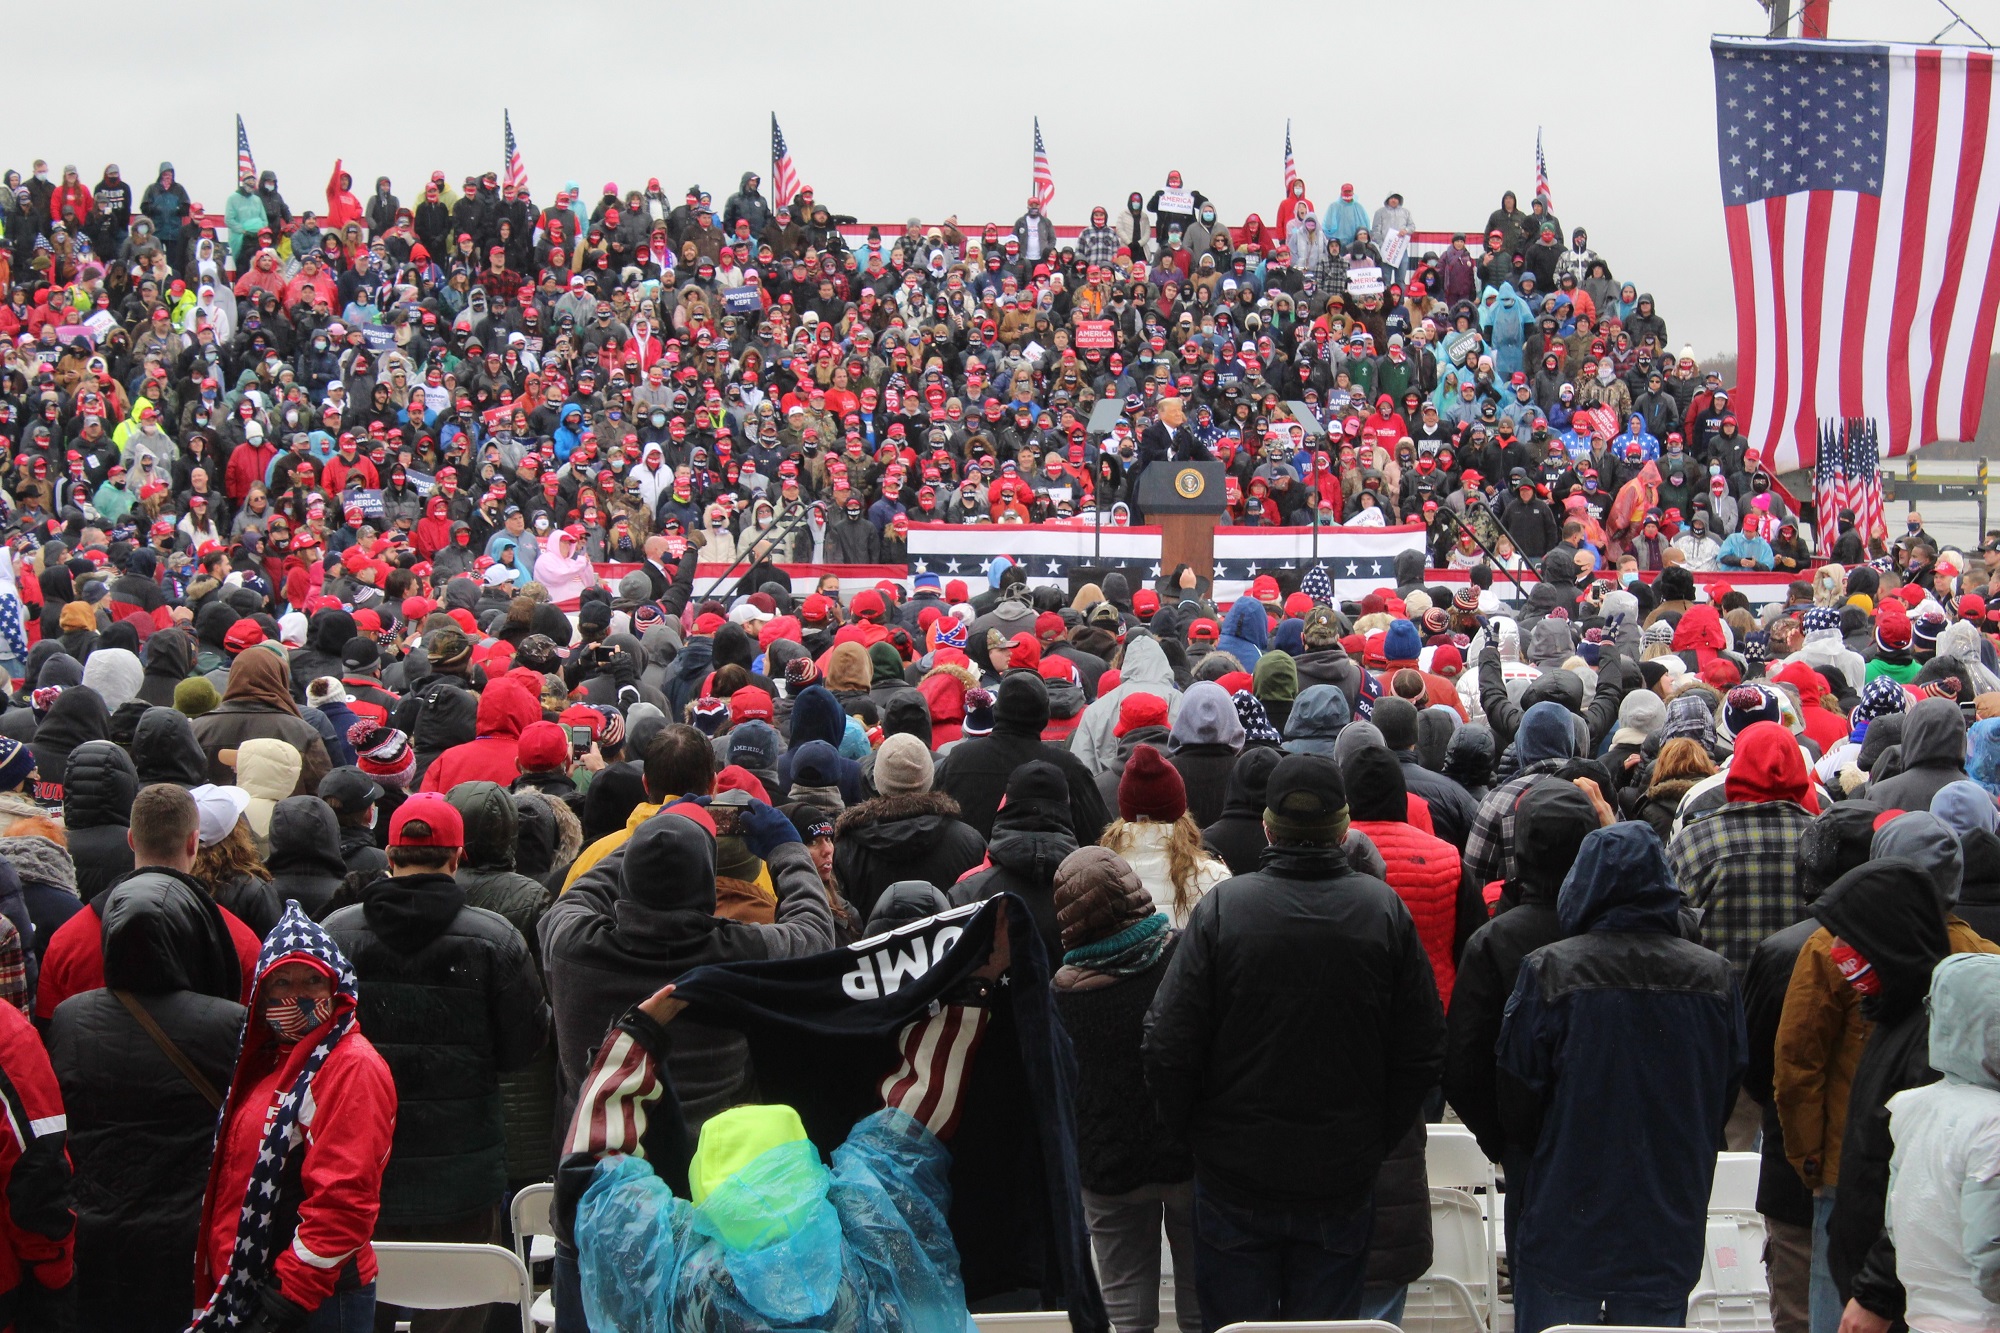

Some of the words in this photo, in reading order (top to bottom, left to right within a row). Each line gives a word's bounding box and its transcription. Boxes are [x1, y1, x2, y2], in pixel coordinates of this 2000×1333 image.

[1161, 195, 1192, 205] AMERICA
[1387, 236, 1400, 262] AMERIC
[1349, 277, 1378, 285] AMERIC
[726, 291, 758, 301] PROMISES
[734, 298, 751, 307] KEPT
[1077, 330, 1113, 338] AMERICA
[370, 336, 386, 345] KEPT
[1595, 408, 1615, 435] MERICA
[1357, 514, 1371, 525] MAKE
[733, 745, 764, 755] AMERICA
[842, 925, 964, 1001] UMP
